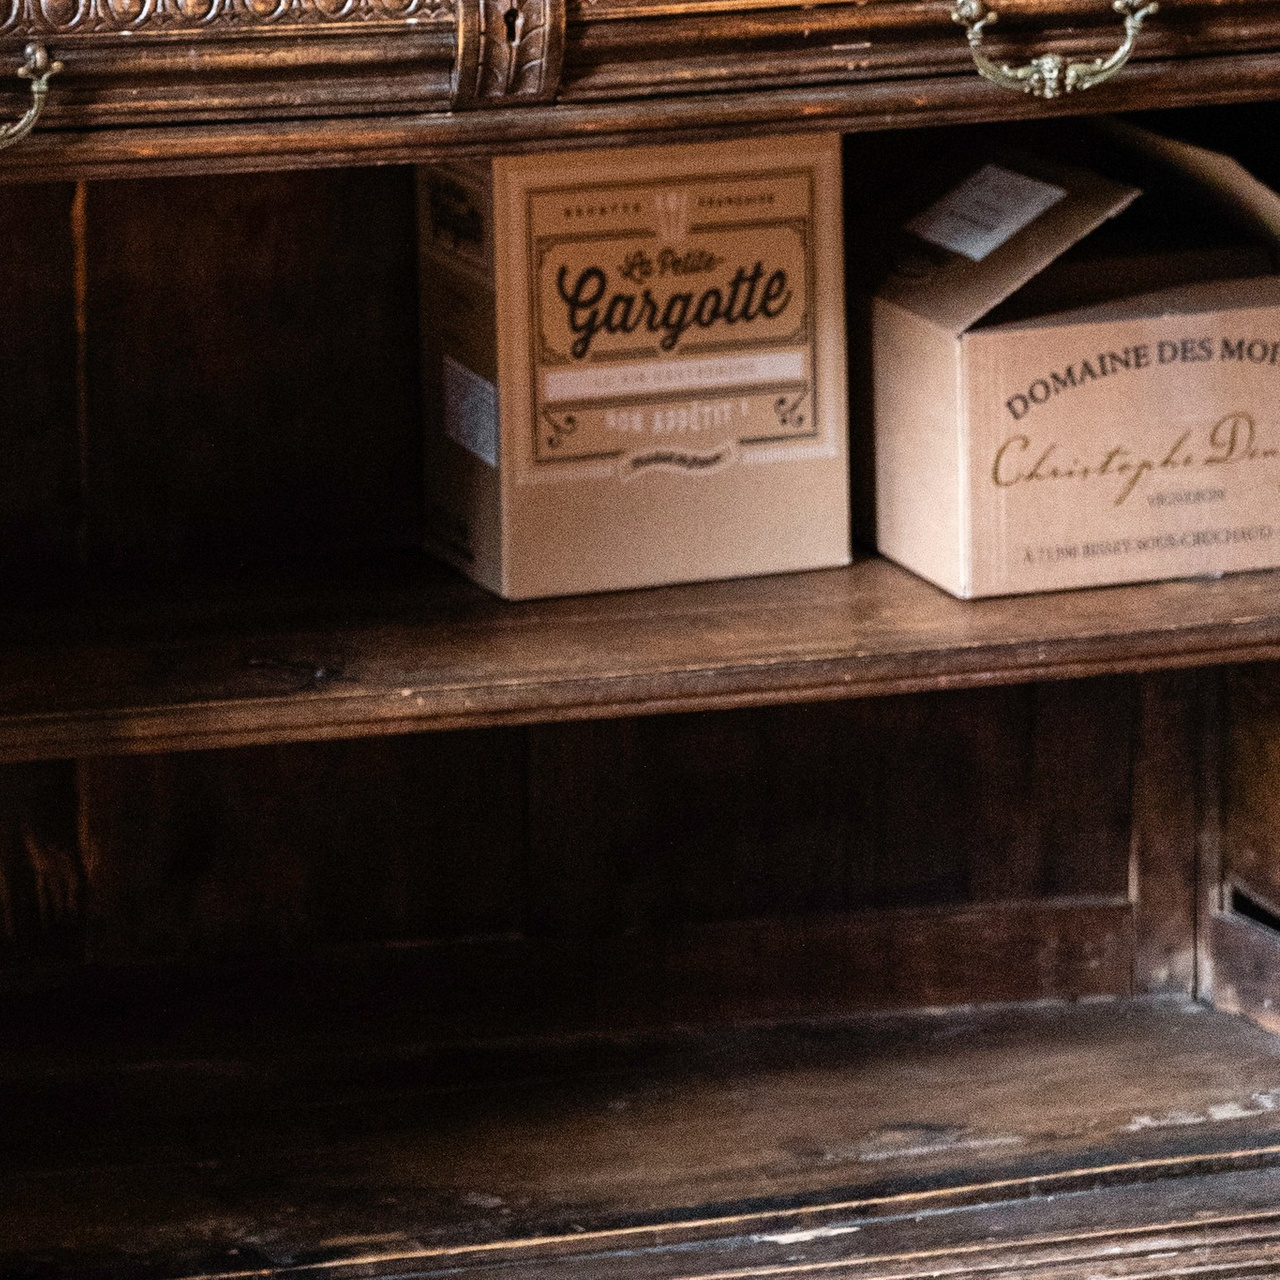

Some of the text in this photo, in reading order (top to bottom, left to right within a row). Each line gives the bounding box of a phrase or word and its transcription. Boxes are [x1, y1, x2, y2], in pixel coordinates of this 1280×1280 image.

[557, 260, 792, 360] Gargotte
[1004, 342, 1150, 421] DOMAINE
[1157, 337, 1213, 364] DES
[991, 434, 1198, 507] Christophe
